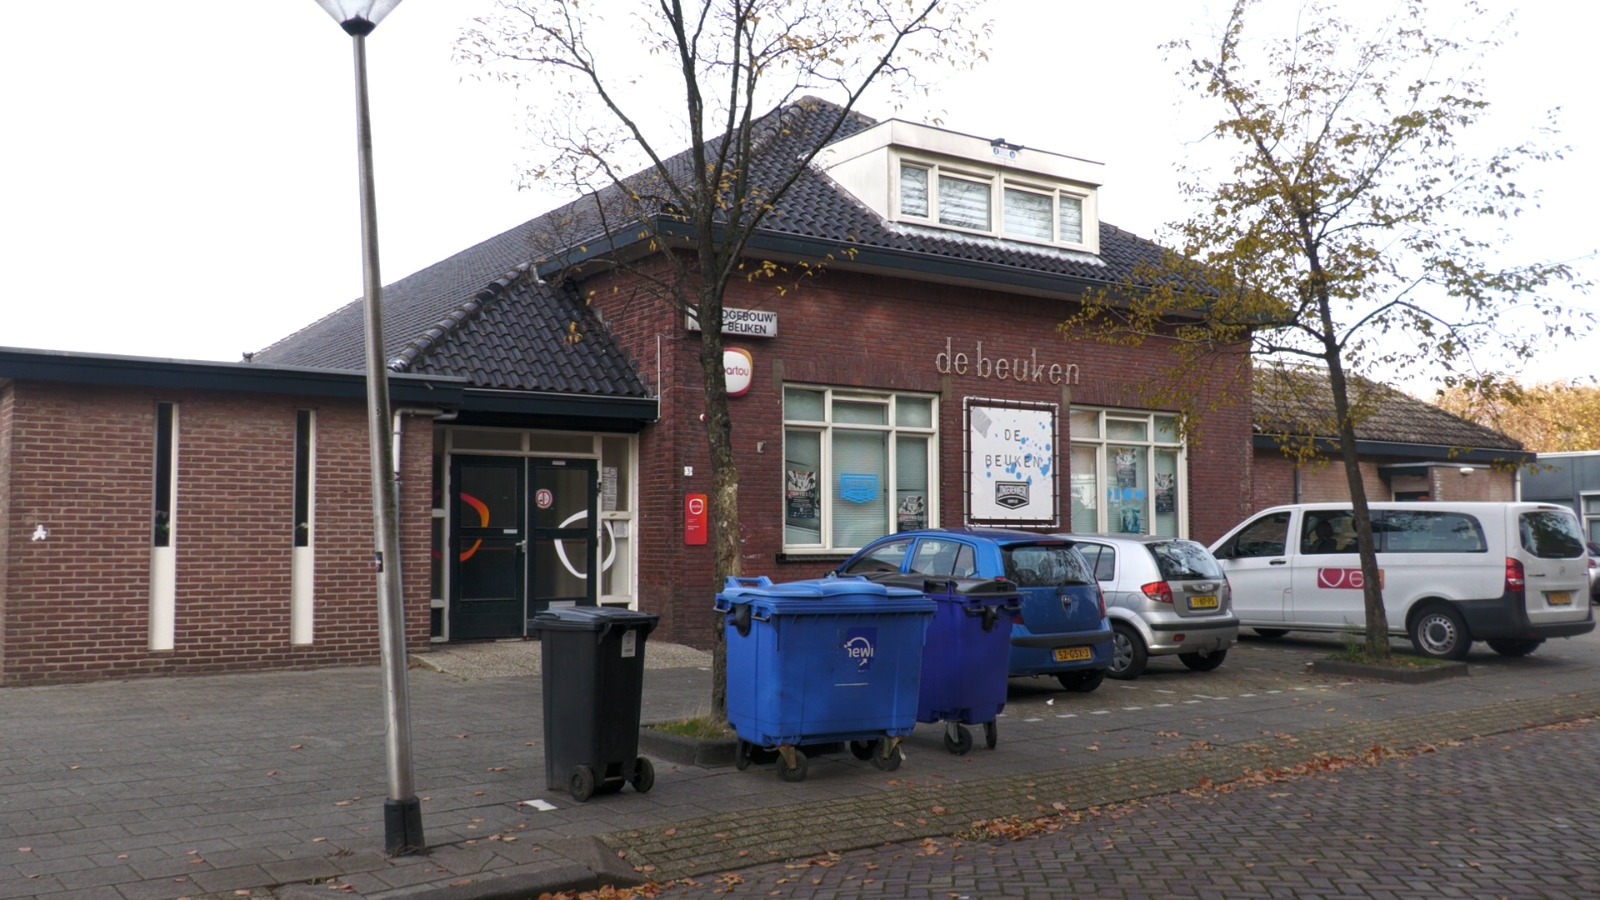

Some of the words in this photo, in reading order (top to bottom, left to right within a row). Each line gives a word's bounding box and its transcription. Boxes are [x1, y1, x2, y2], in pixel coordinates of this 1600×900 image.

[721, 309, 773, 323] DGEBOUW
[727, 322, 767, 334] BEUKEN
[935, 336, 969, 375] de
[976, 340, 1080, 385] beuken
[724, 365, 748, 376] artou
[1004, 429, 1021, 442] DE
[985, 454, 1041, 468] BEUKEN
